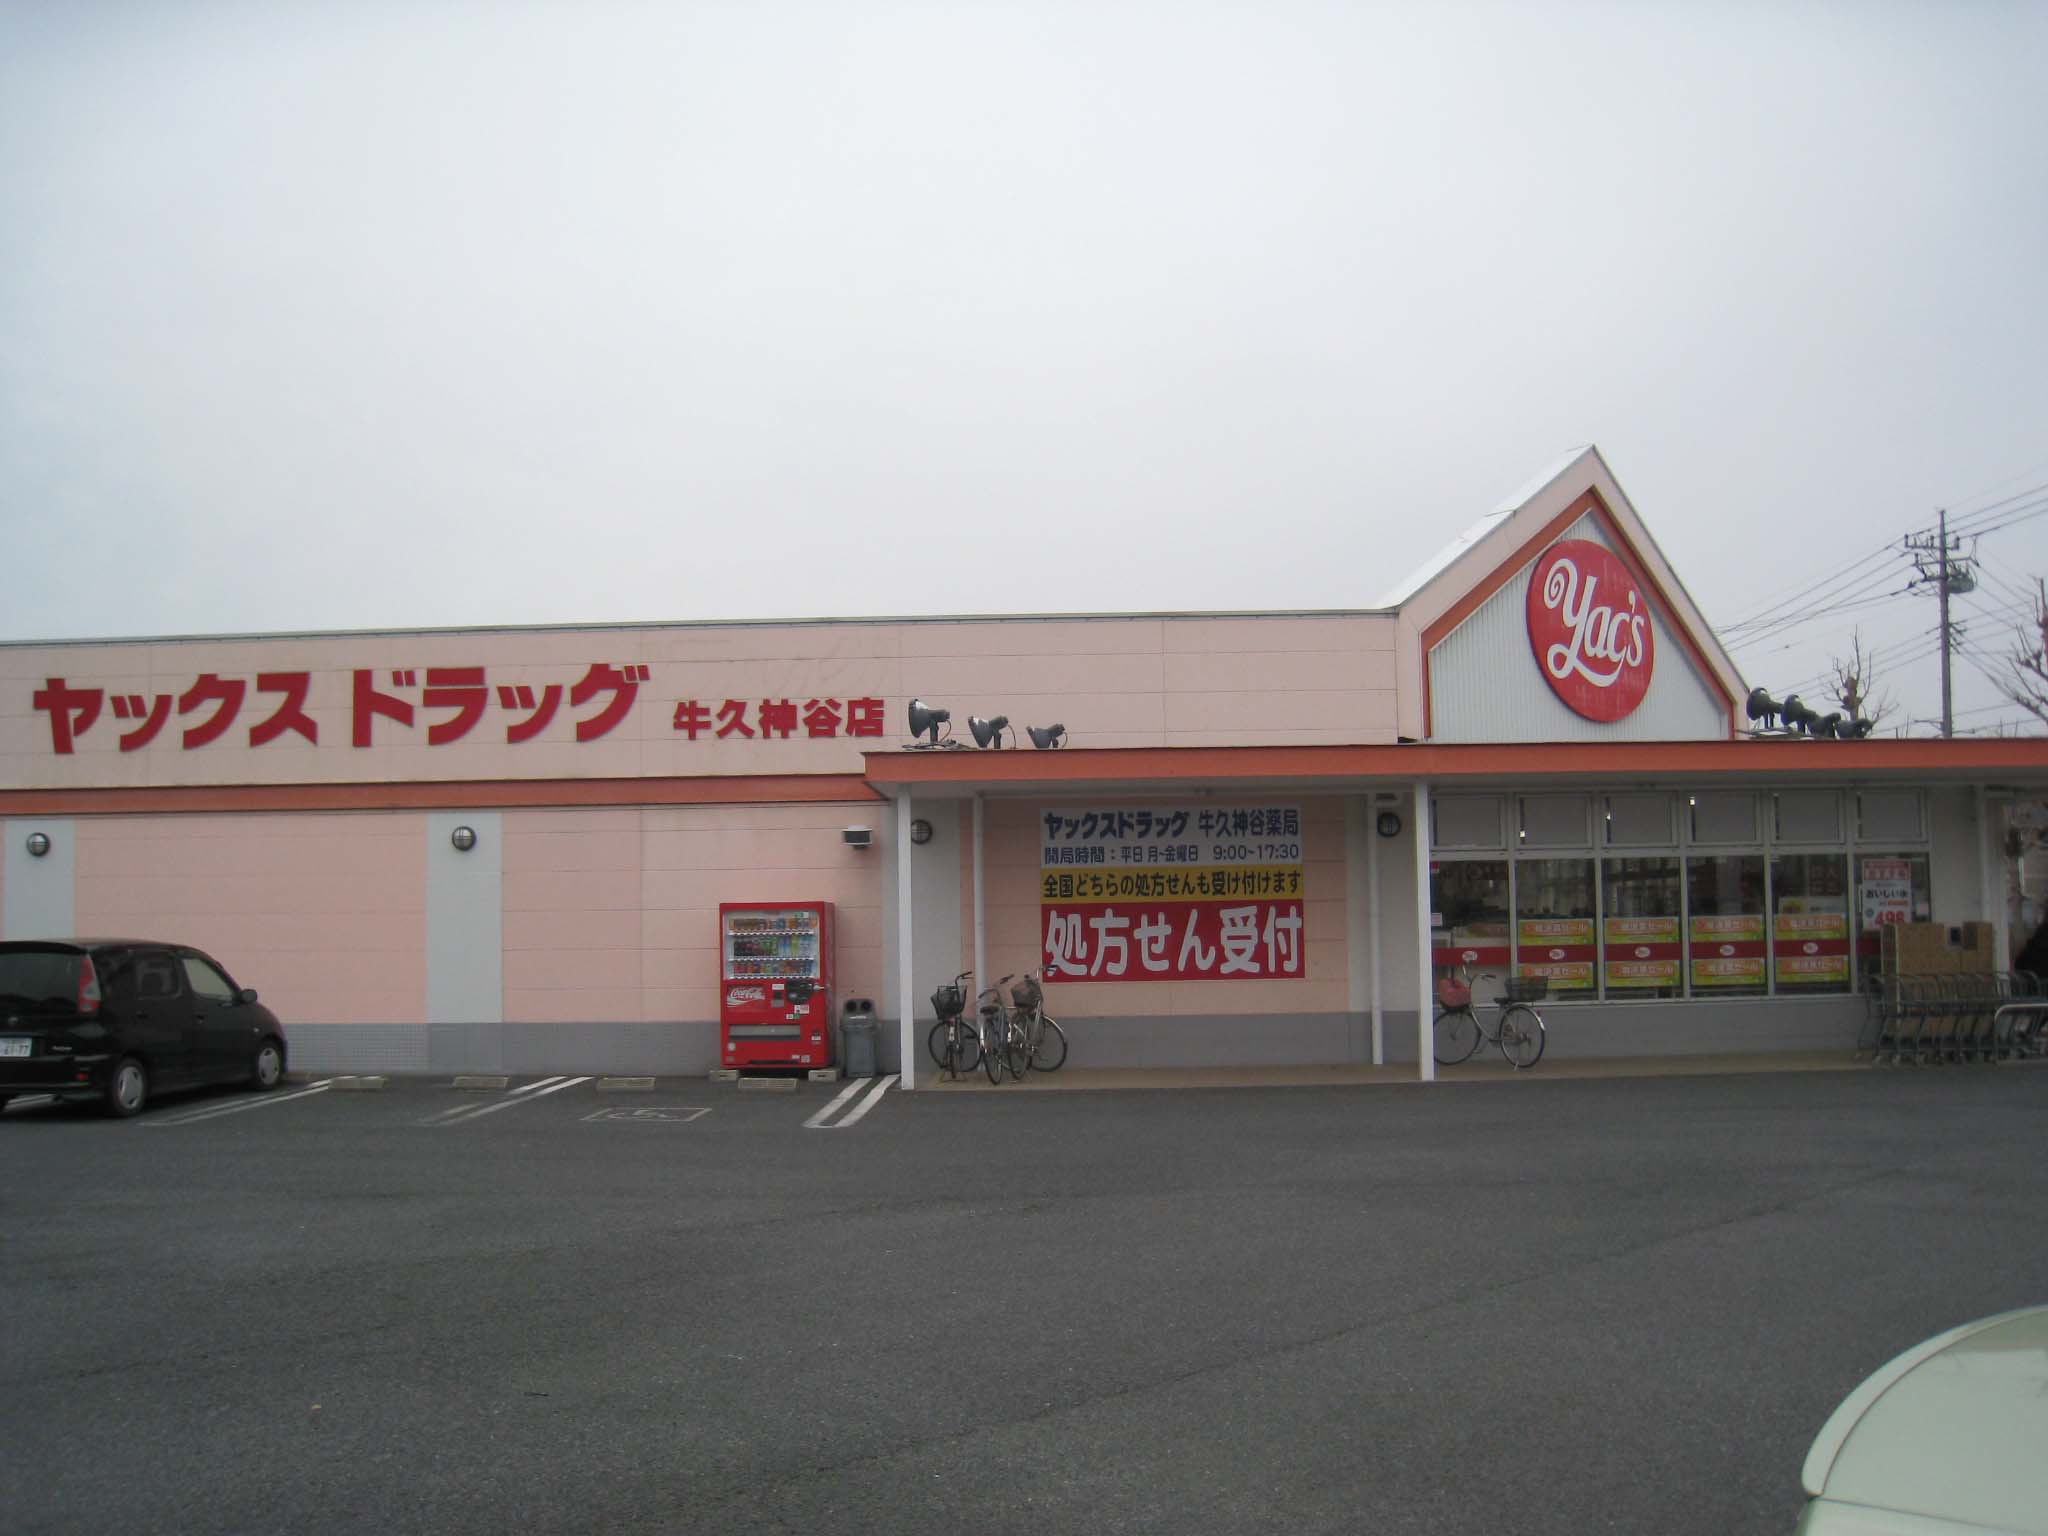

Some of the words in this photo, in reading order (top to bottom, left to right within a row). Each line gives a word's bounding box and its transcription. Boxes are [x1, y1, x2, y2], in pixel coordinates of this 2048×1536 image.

[1544, 558, 1645, 688] Yac's
[33, 671, 318, 755] ヤックス
[353, 663, 651, 747] ドラッグ
[673, 697, 885, 740] 牛久神谷店
[1045, 811, 1190, 840] ヤックスドラッグ
[1200, 809, 1299, 837] 牛久神谷薬局
[1044, 870, 1301, 898] 全国どちらの処方せんも受け付けます
[1046, 905, 1302, 976] 処方せん受付
